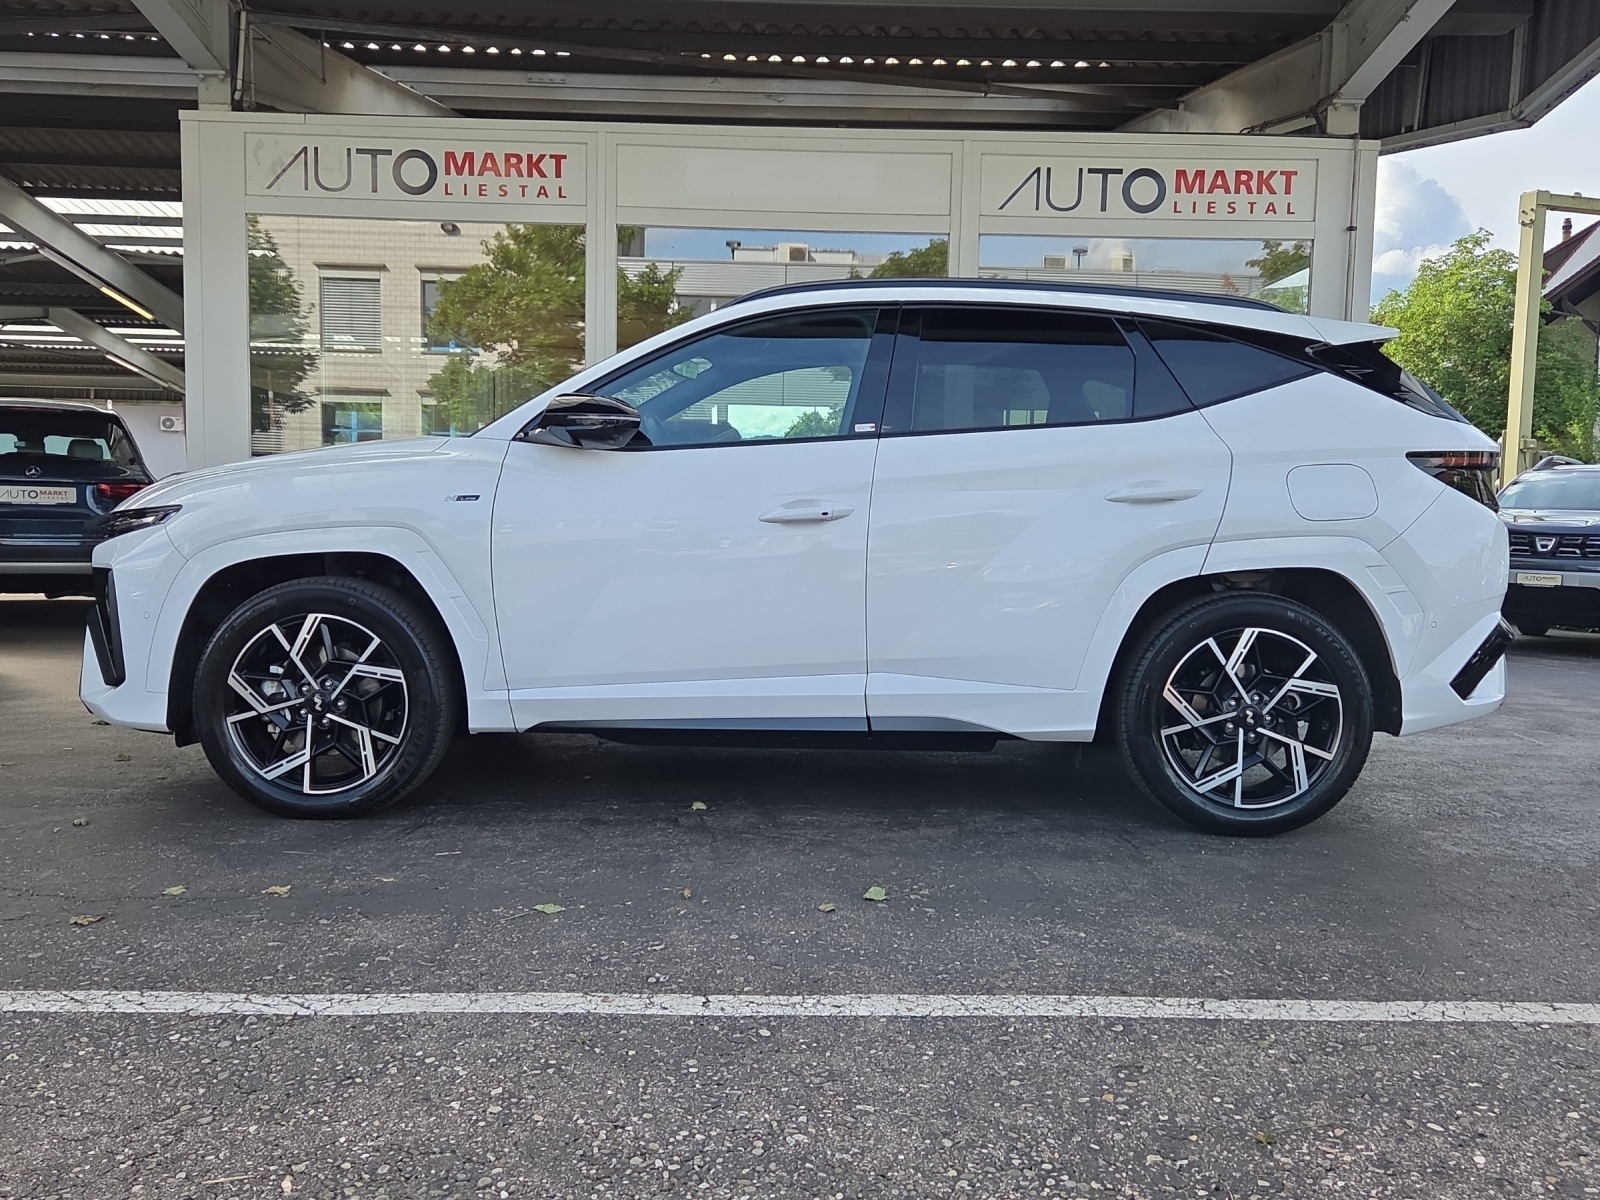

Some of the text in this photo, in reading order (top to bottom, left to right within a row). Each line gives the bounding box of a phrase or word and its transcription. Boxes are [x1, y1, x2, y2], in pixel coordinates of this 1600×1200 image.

[265, 146, 567, 195] AUTO MARKT
[444, 183, 567, 198] LIESTAL
[998, 167, 1298, 213] AUTO MARKT
[1173, 201, 1295, 214] LIESTAL
[0, 489, 38, 499] AUTO
